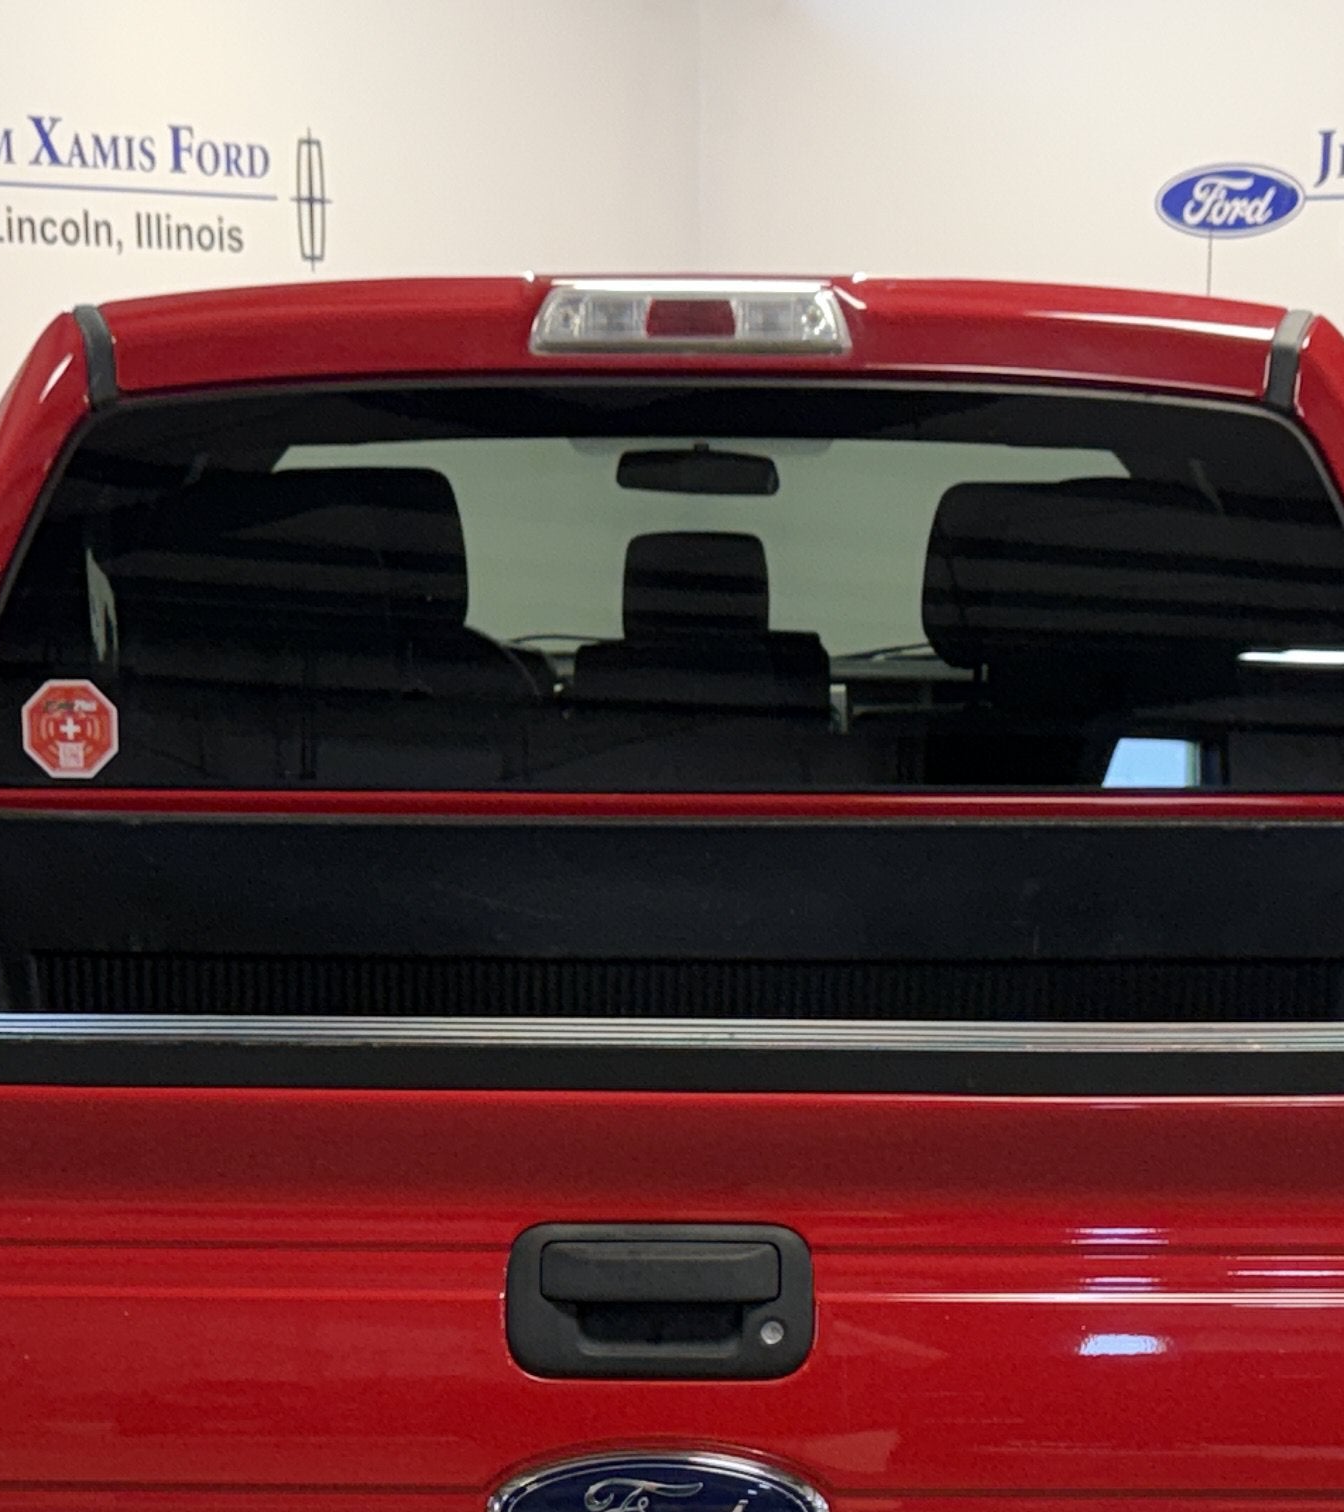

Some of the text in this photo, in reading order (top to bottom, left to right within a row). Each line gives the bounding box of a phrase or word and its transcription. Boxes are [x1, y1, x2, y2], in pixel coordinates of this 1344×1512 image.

[27, 116, 157, 172] XAMIS
[168, 124, 271, 179] FORD
[1182, 176, 1276, 227] Ford
[135, 212, 245, 254] Illinois
